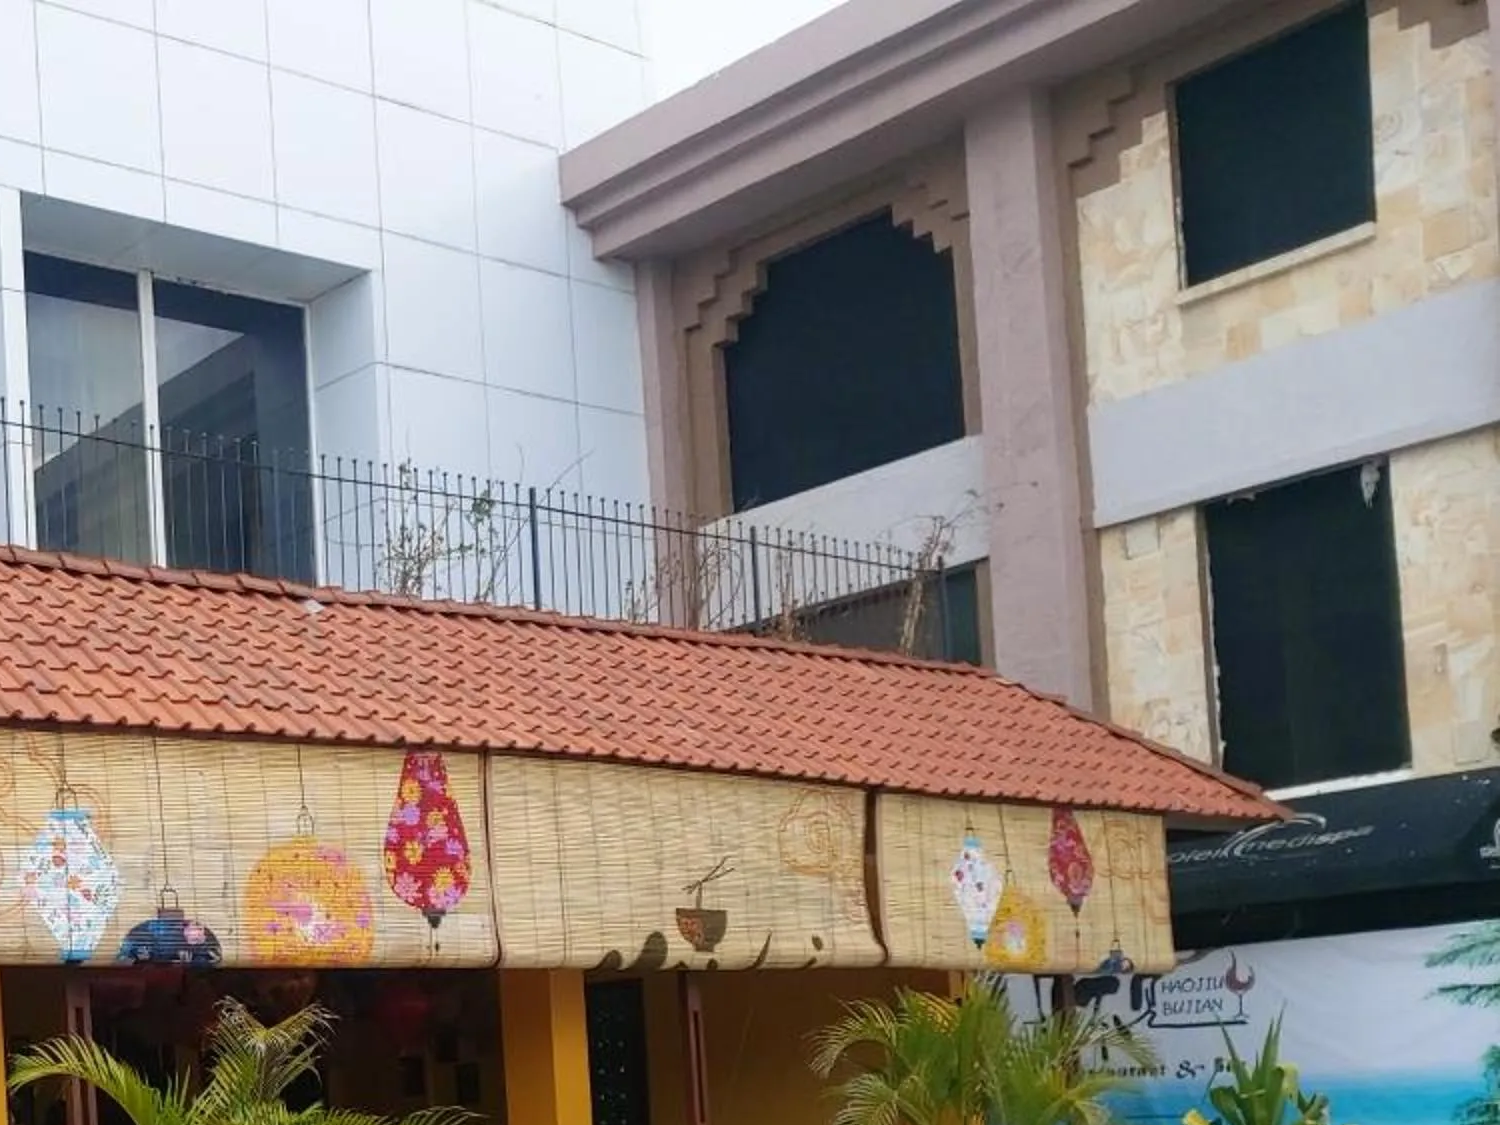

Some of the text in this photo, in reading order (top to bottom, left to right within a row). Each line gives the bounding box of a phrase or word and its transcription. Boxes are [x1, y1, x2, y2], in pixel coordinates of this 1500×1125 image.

[1162, 975, 1225, 993] HAOJIU
[1163, 998, 1223, 1016] BUJIAN
[1176, 1059, 1205, 1079] &
